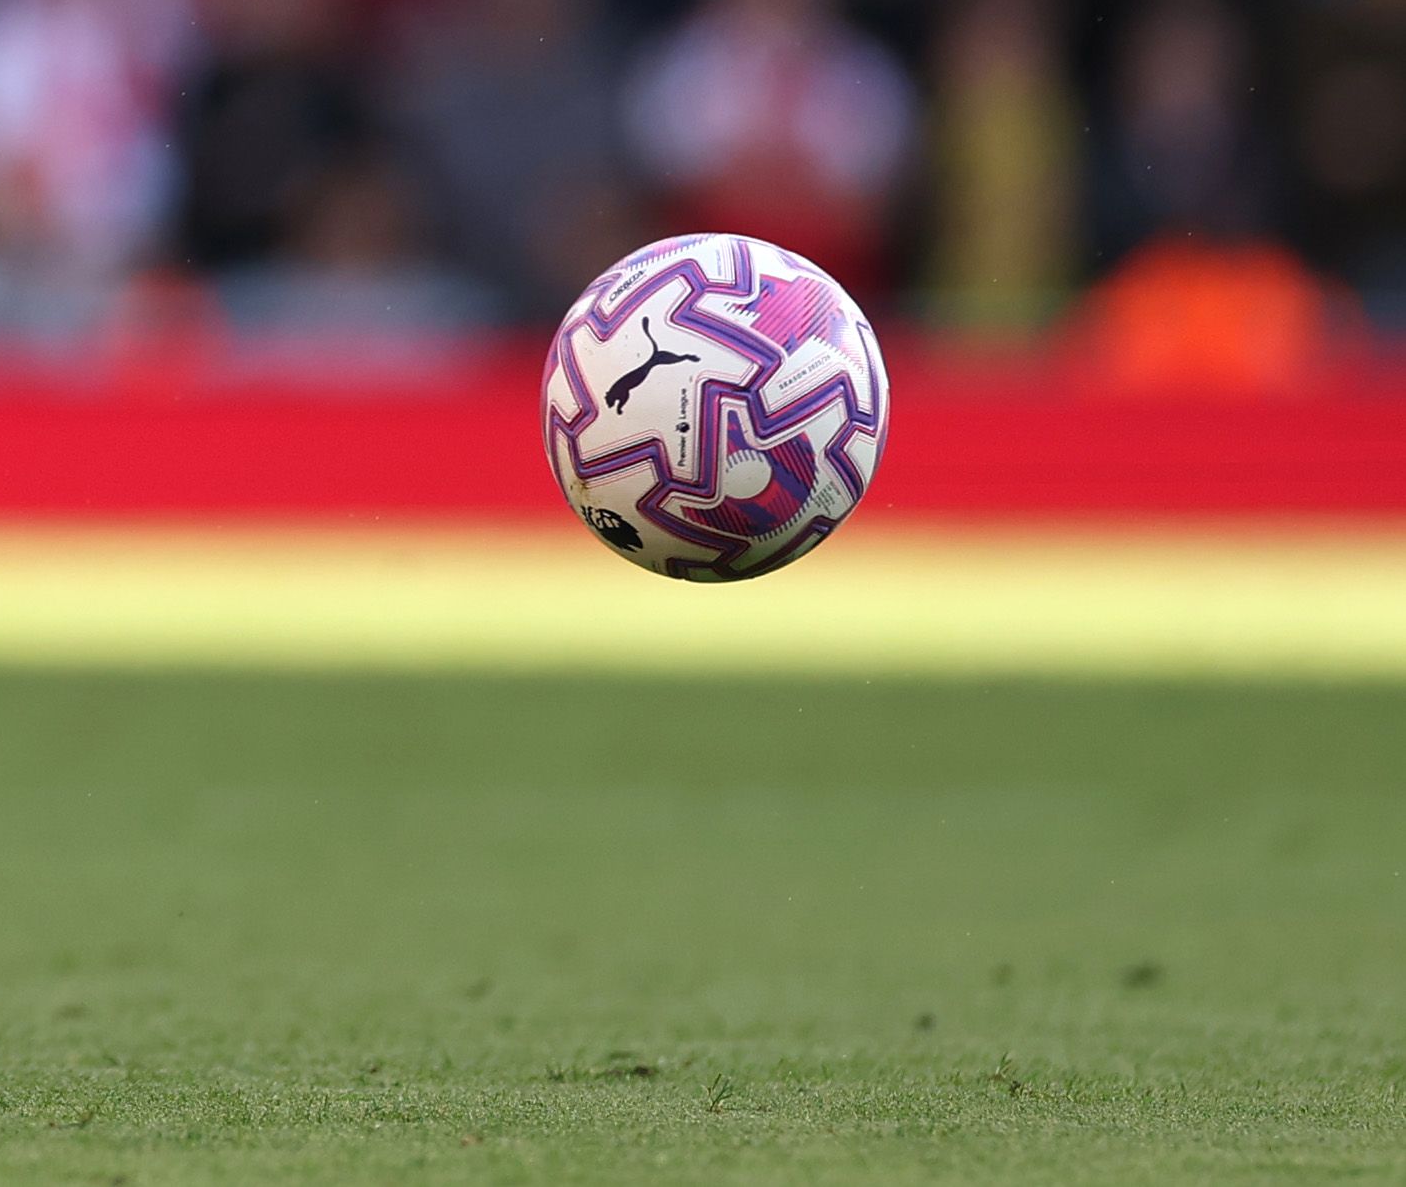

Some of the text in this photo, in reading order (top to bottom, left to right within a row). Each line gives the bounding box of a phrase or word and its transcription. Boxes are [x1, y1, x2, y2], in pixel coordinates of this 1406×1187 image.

[778, 369, 808, 390] SEASON
[676, 388, 689, 468] Premier League
